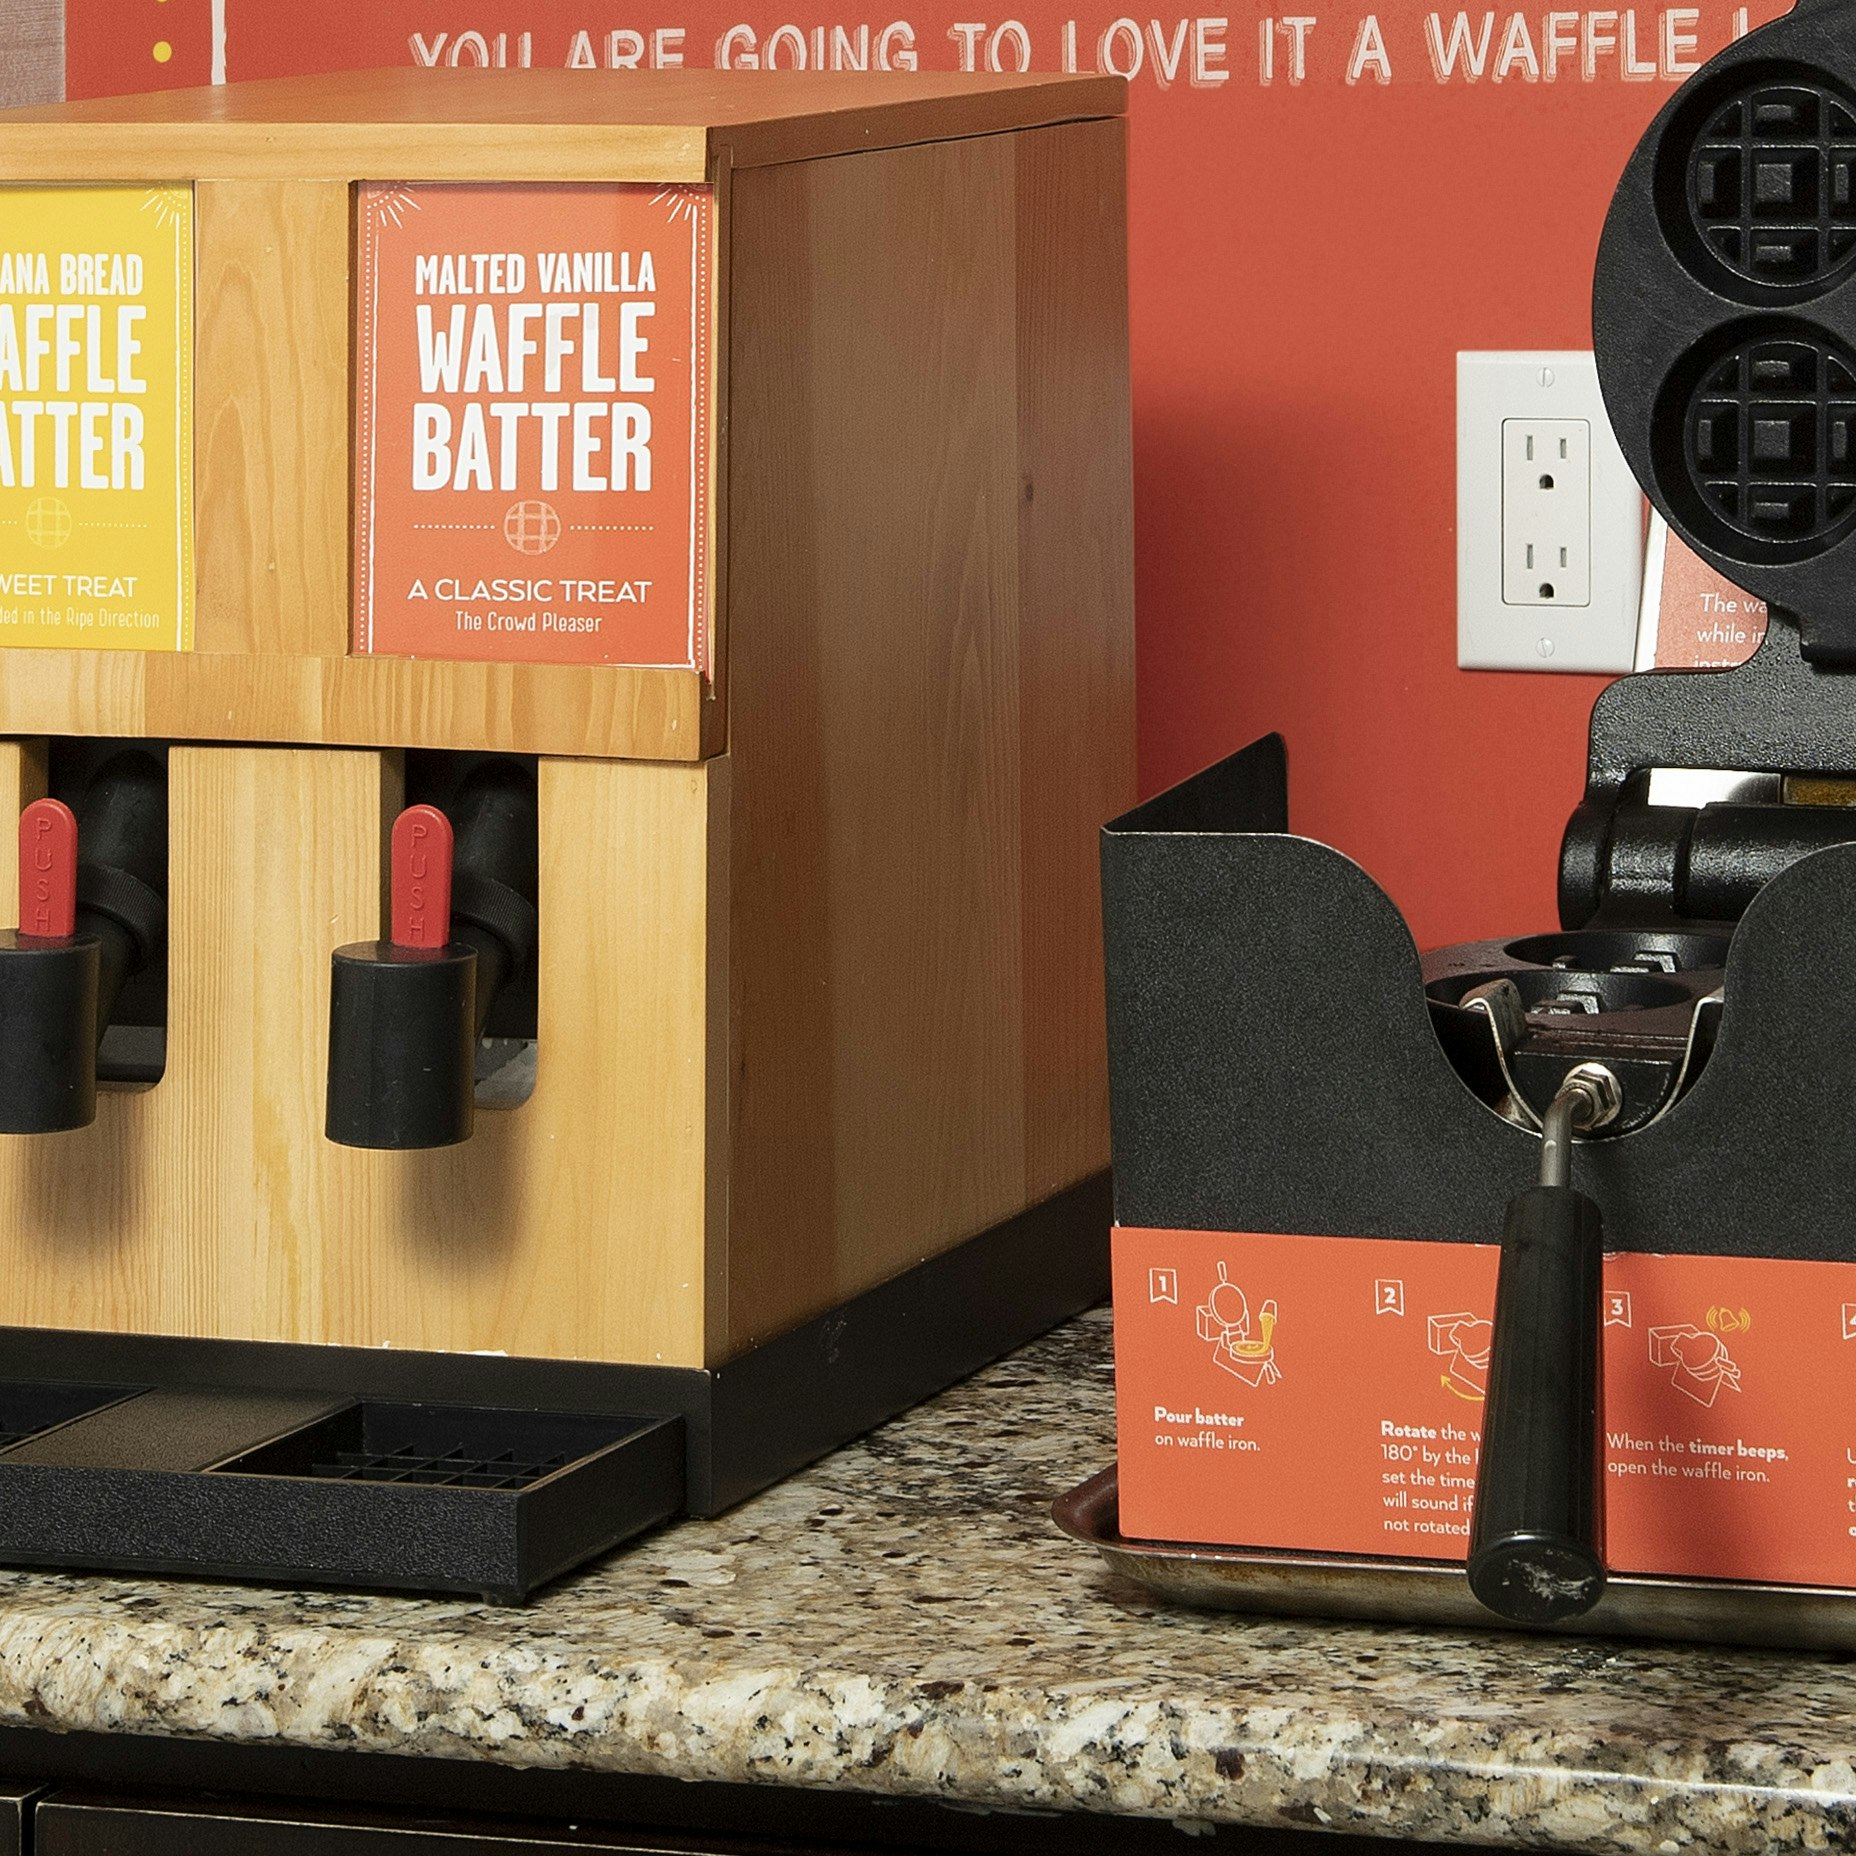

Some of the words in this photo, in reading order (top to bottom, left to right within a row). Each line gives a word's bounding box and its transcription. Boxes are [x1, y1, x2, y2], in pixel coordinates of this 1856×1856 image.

[715, 20, 918, 71] GOING
[948, 20, 1031, 73] TO
[1061, 16, 1229, 88] LOVE
[1260, 16, 1316, 86] IT
[1346, 15, 1391, 85] A
[1424, 9, 1701, 84] WAFFLE
[59, 252, 144, 297] BREAD
[415, 253, 526, 294] MALTED
[537, 251, 656, 293] VANILLA
[416, 302, 656, 394] WAFFLE
[411, 401, 653, 493] BATTER
[62, 574, 138, 598] TREAT
[407, 579, 429, 600] A
[434, 578, 553, 602] CLASSIC
[559, 580, 653, 604] TREAT
[1700, 592, 1738, 614] The
[23, 608, 35, 625] in
[40, 607, 61, 626] the
[67, 607, 94, 630] Ripe
[99, 608, 160, 629] Direction
[455, 610, 482, 631] The
[488, 611, 536, 632] Crowd
[542, 612, 602, 633] Pleaser
[1697, 622, 1746, 644] while
[35, 817, 52, 933] PUSH
[409, 824, 427, 942] PUSH
[1158, 1275, 1169, 1292] 1
[1384, 1287, 1396, 1305] 2
[1611, 1299, 1624, 1316] 3
[1154, 1406, 1193, 1424] Pour
[1195, 1407, 1244, 1427] batter
[1155, 1434, 1173, 1446] on
[1177, 1431, 1225, 1449] waffle
[1228, 1434, 1260, 1451] iron.
[1380, 1420, 1437, 1439] Rotate
[1440, 1423, 1466, 1441] the
[1422, 1445, 1441, 1466] by
[1445, 1447, 1471, 1465] the
[1607, 1432, 1654, 1452] When
[1658, 1435, 1685, 1453] the
[1689, 1438, 1734, 1456] timer
[1737, 1439, 1789, 1462] beeps,
[1382, 1471, 1406, 1485] set
[1410, 1468, 1435, 1486] the
[1440, 1472, 1475, 1489] time
[1608, 1461, 1647, 1477] open
[1651, 1458, 1678, 1476] the
[1681, 1461, 1732, 1480] waffle
[1736, 1465, 1770, 1483] iron.
[1383, 1491, 1407, 1508] will
[1411, 1494, 1458, 1511] sound
[1463, 1495, 1474, 1512] if
[1384, 1519, 1409, 1532] not
[1414, 1518, 1470, 1536] rotated
